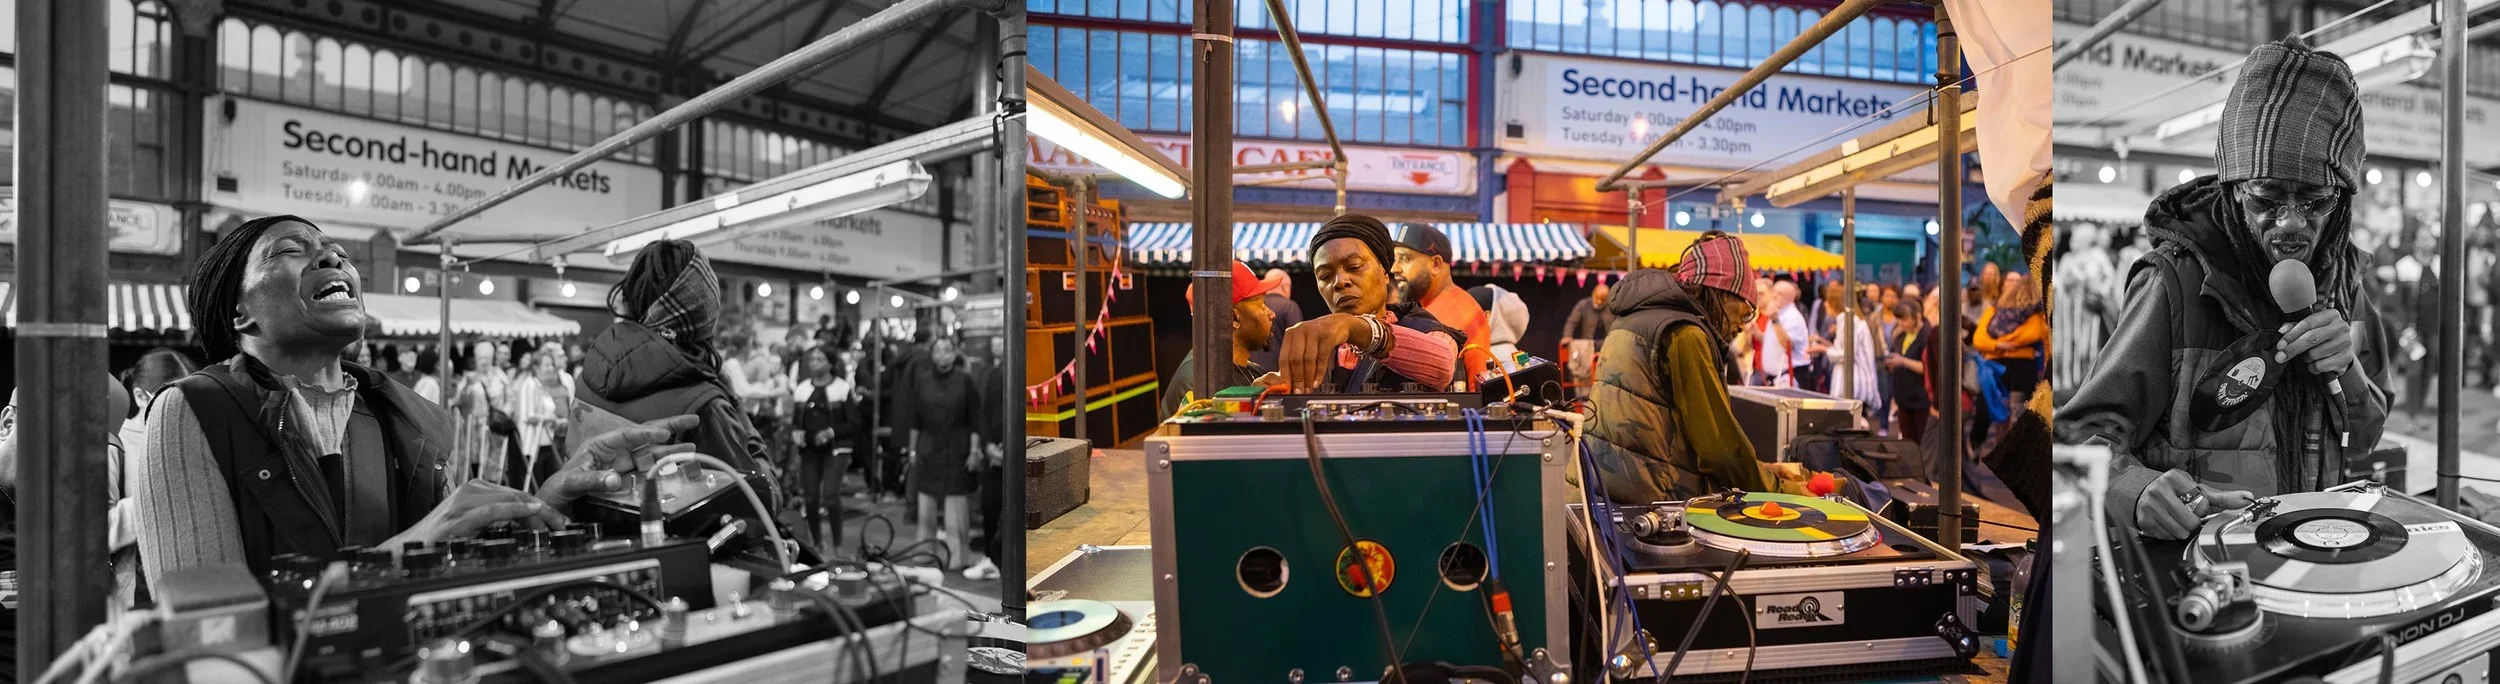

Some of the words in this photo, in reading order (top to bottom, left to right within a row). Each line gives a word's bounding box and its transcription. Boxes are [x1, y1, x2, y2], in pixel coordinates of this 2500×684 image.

[1777, 87, 1893, 120] Markets
[1562, 105, 1630, 126] Saturday
[1704, 116, 1757, 134] 4.00pm
[283, 119, 497, 177] Second-hand
[1562, 127, 1625, 147] Tuesday
[1698, 136, 1752, 155] 3.30pm
[1392, 157, 1447, 172] ENTRANCE
[282, 161, 357, 186] Saturday
[434, 181, 486, 200] 4.00pm
[282, 183, 351, 208] Tuesday
[357, 192, 414, 212] .00am
[1766, 604, 1801, 614] Road
[2438, 607, 2465, 628] DJ
